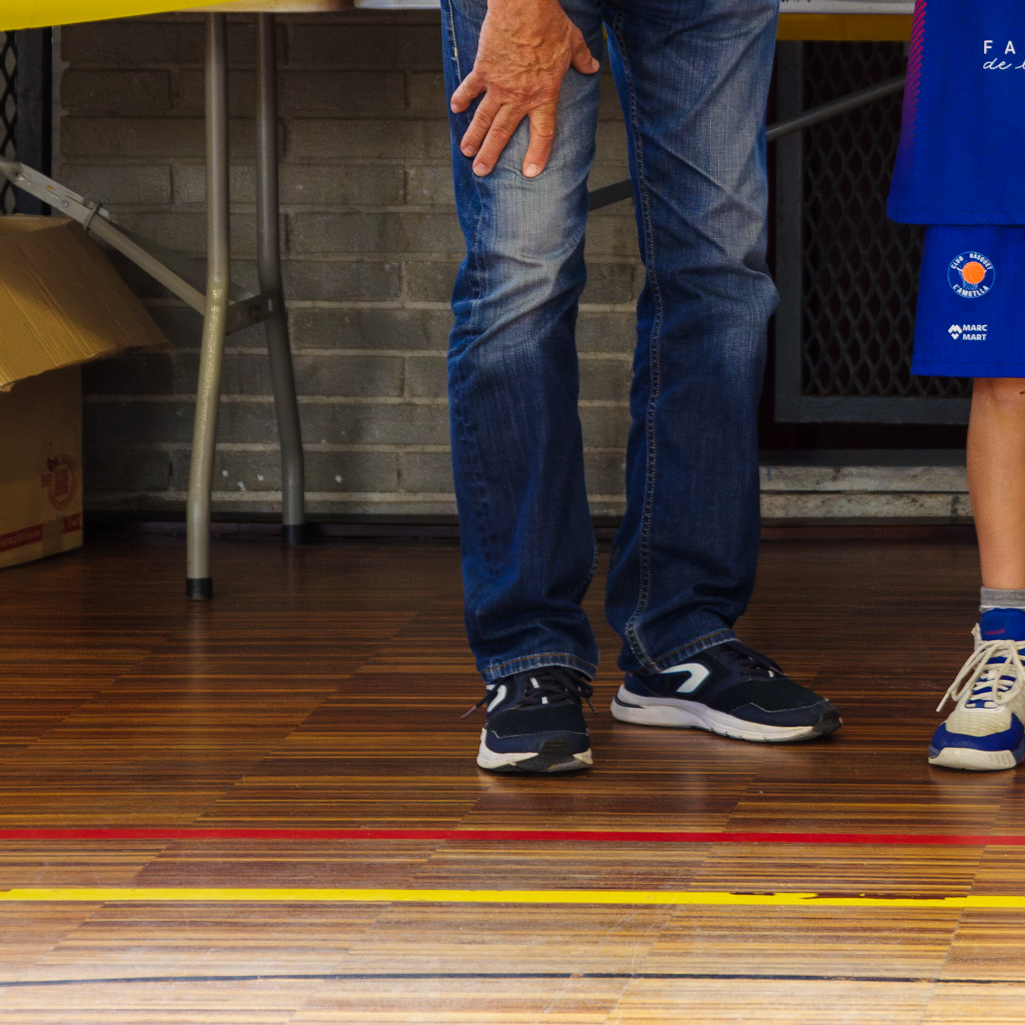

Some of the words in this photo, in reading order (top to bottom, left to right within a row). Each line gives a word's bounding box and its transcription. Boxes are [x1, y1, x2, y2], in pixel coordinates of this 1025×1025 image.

[982, 58, 1012, 70] de
[950, 255, 964, 270] CLUB
[962, 324, 988, 332] MARC
[962, 333, 987, 341] MART
